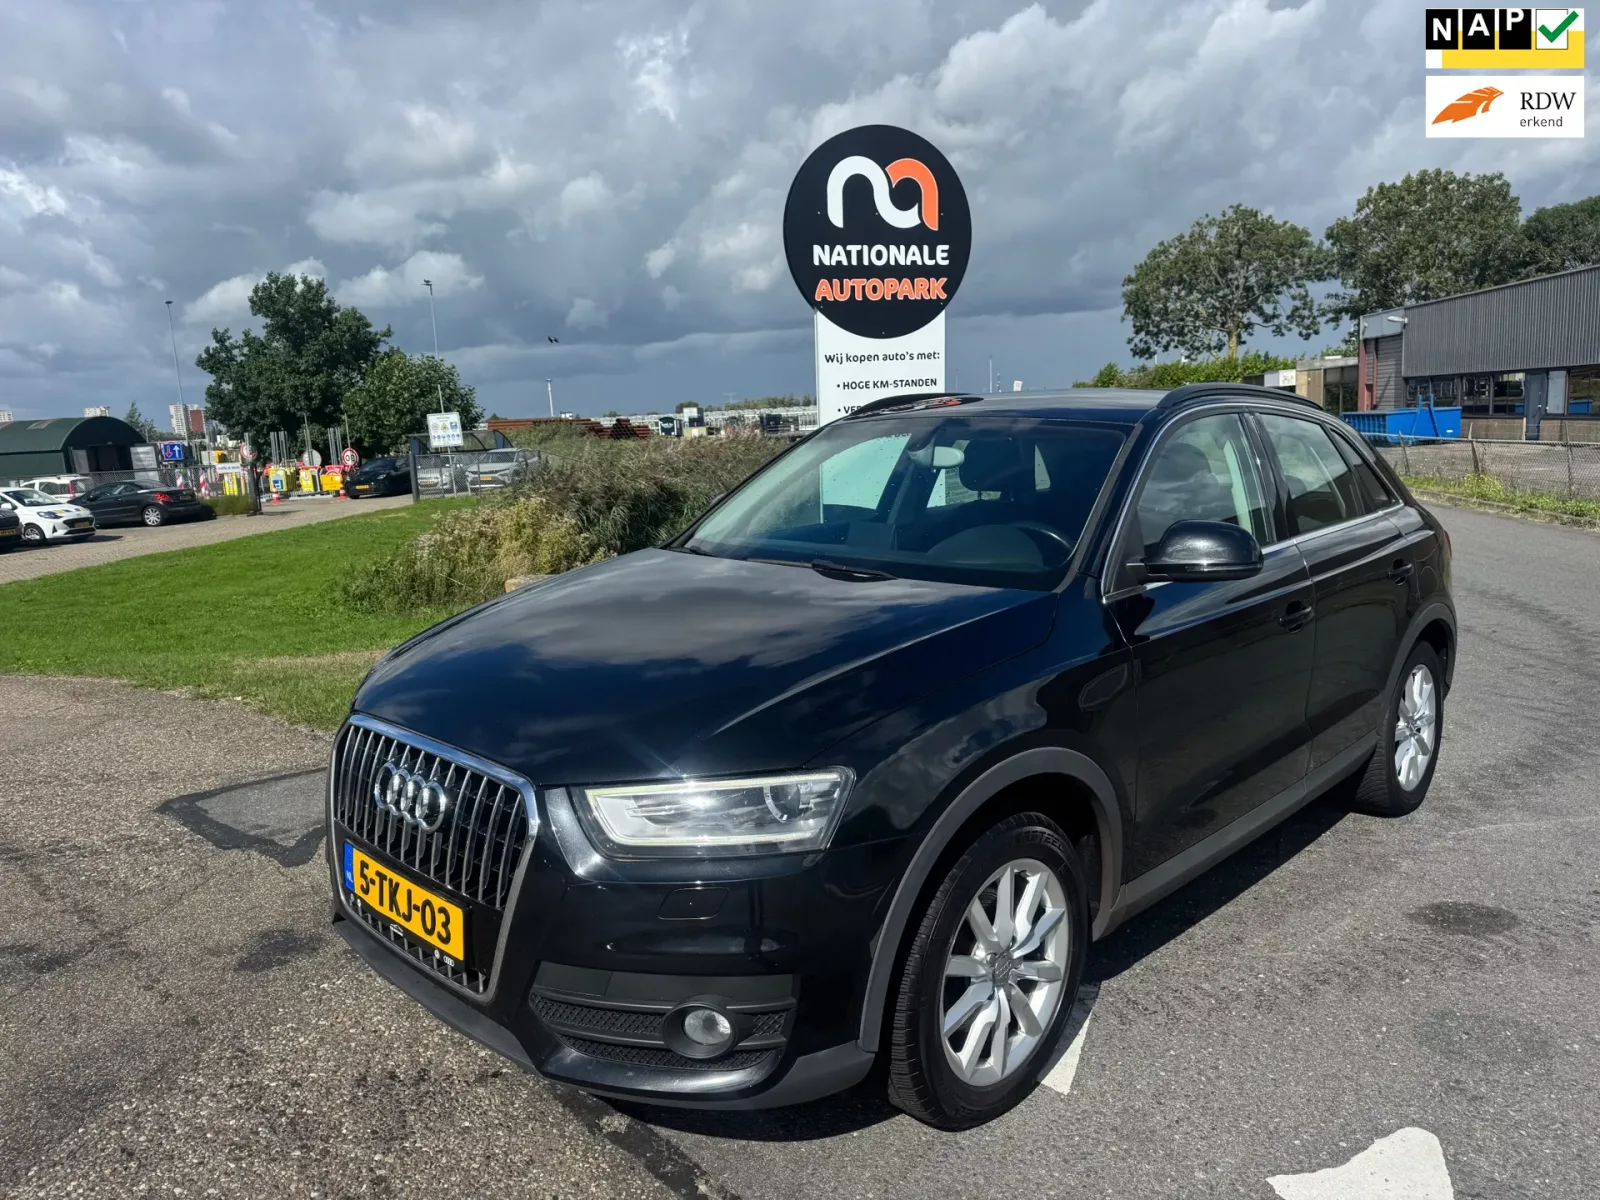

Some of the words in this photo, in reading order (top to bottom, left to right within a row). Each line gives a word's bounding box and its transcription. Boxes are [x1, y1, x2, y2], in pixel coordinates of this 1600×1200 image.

[813, 244, 950, 266] NATIONALE
[815, 277, 948, 301] AUTOPARK
[824, 353, 844, 364] Wij
[845, 352, 880, 363] kopen
[882, 350, 915, 361] auto's
[916, 350, 940, 361] met:
[842, 380, 871, 390] HOGE
[873, 378, 937, 389] KM-STANDEN
[359, 859, 452, 946] 5-TKJ-03
